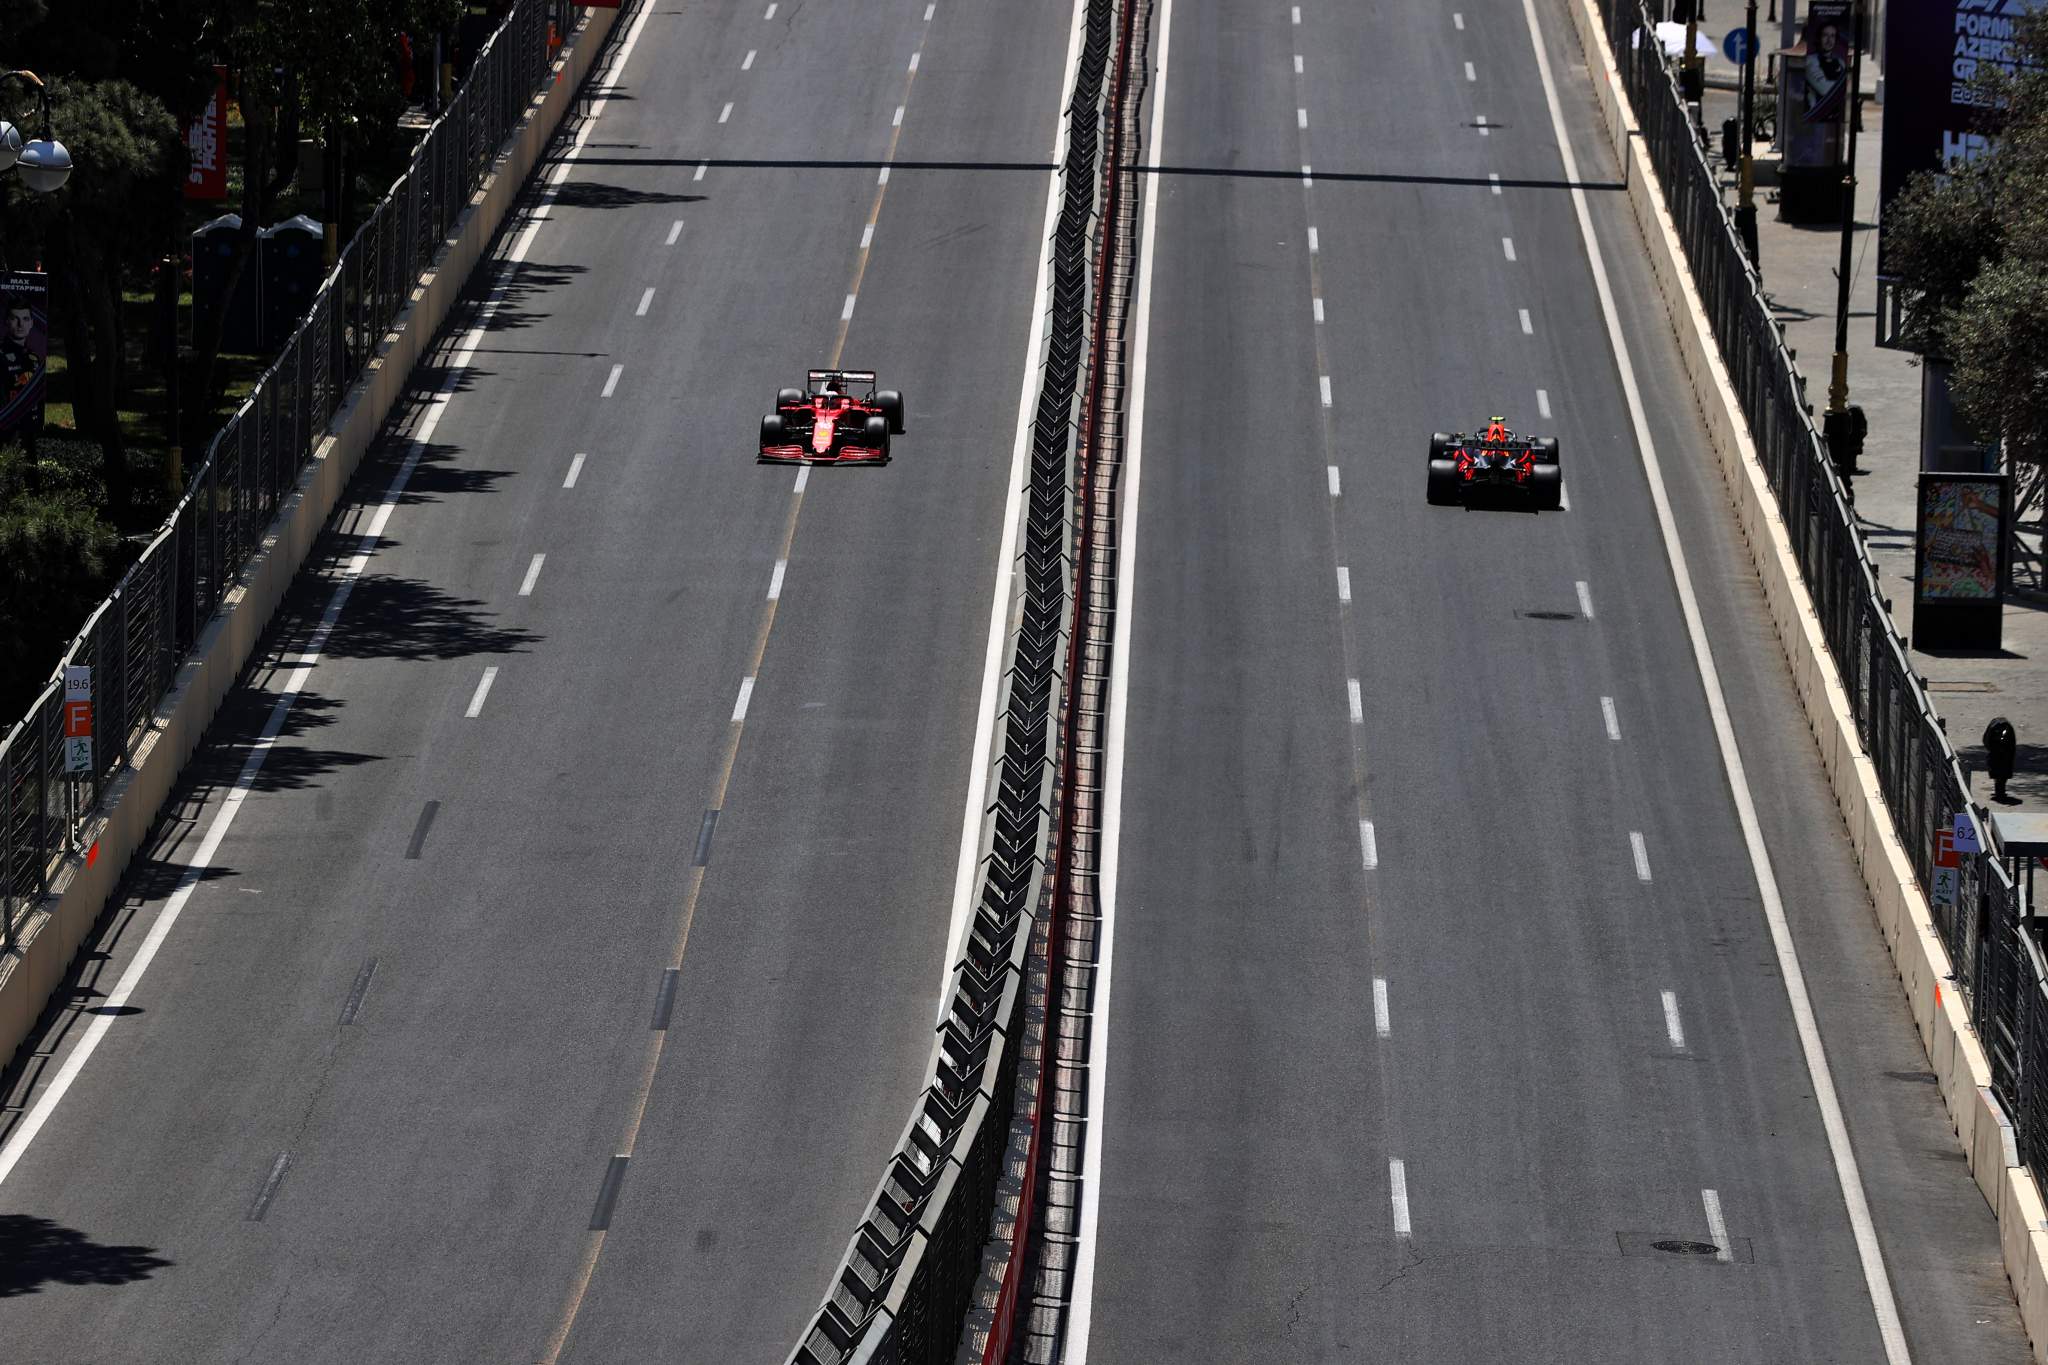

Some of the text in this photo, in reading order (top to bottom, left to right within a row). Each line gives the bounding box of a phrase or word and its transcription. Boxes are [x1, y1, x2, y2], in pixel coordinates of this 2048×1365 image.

[0, 284, 46, 292] ERSTAPPEN
[69, 679, 88, 690] 19.6
[72, 706, 88, 733] F
[1957, 826, 1976, 841] 6.2
[1938, 835, 1953, 862] F
